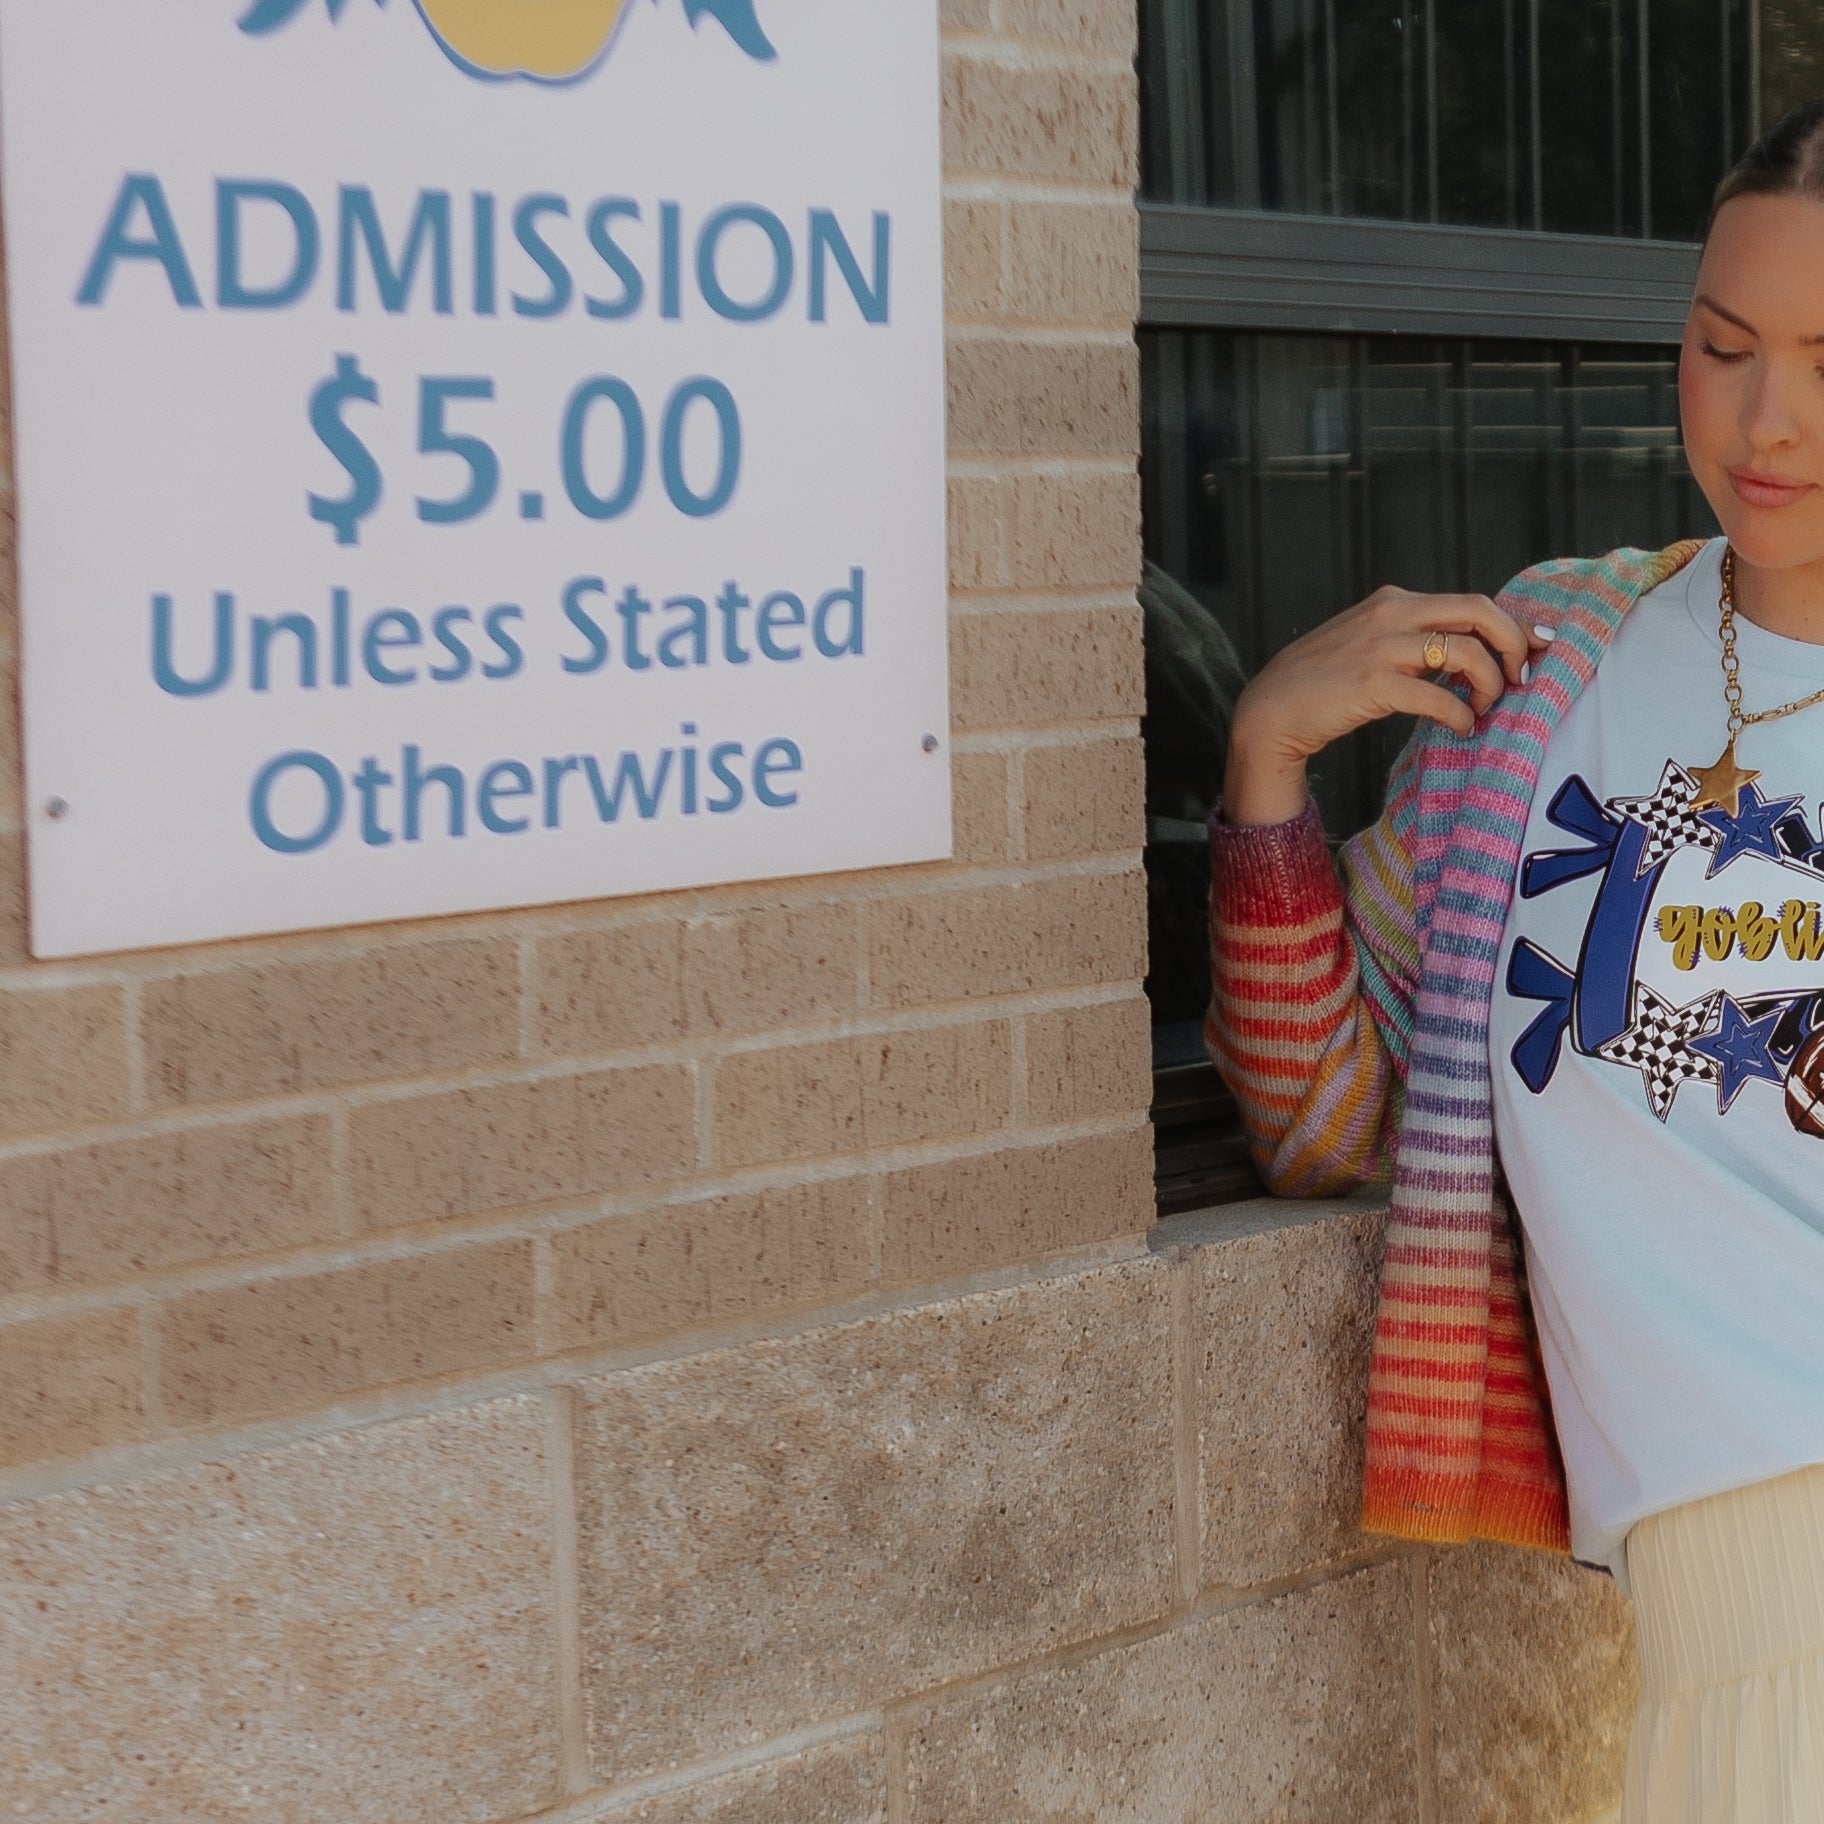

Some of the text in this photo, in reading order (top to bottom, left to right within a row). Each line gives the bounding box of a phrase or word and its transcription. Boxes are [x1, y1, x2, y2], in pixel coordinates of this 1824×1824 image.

[73, 171, 892, 326] ADMISSION
[305, 352, 743, 547] $5.00
[149, 565, 867, 699] Unless Stated
[247, 722, 804, 856] Otherwise
